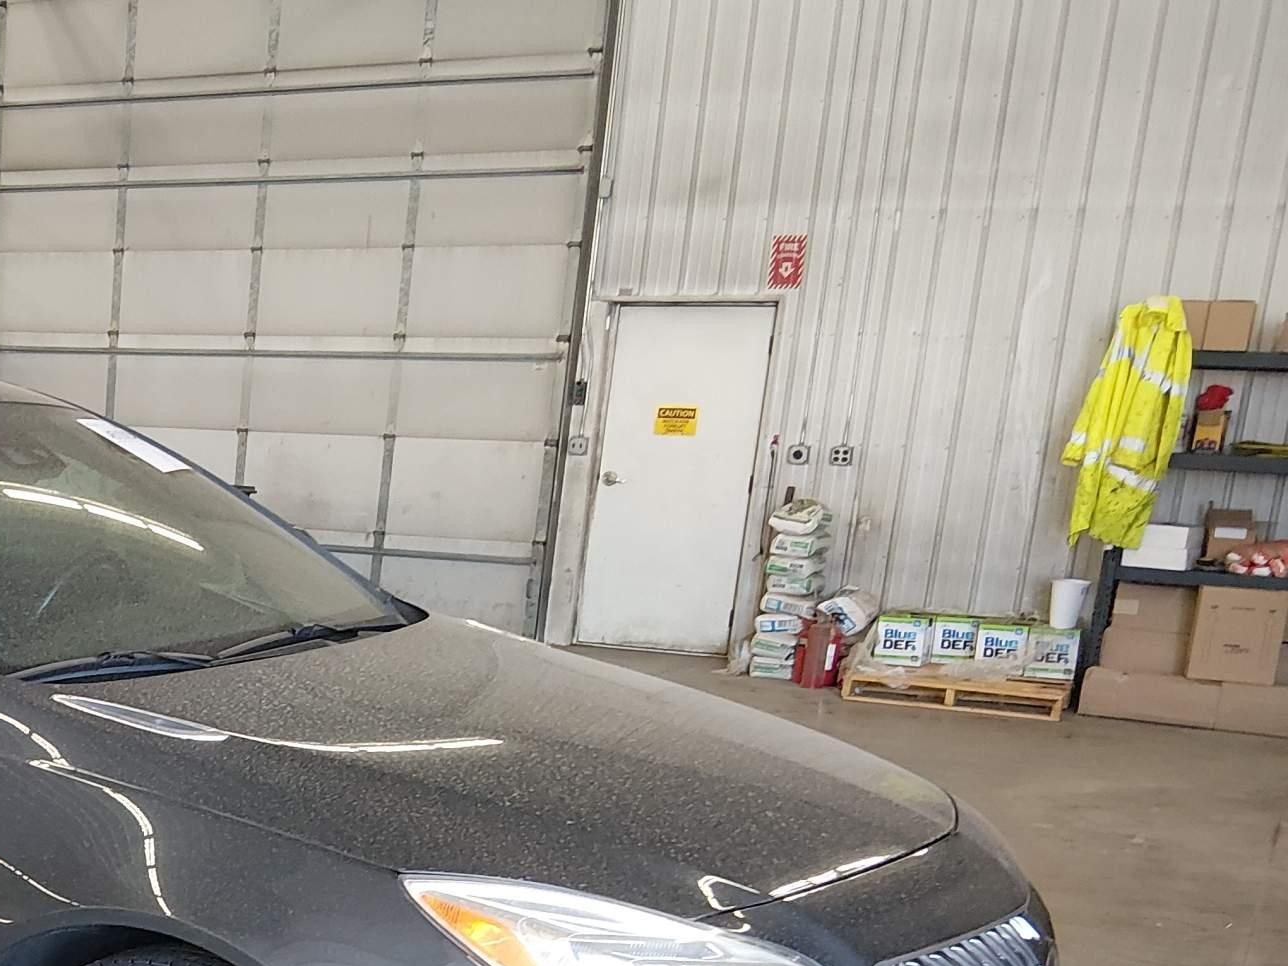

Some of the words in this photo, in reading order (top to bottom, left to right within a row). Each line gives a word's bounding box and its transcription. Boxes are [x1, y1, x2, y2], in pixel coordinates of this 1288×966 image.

[659, 409, 696, 418] CAUTION
[884, 628, 917, 640] Blue
[942, 628, 975, 640] Blue
[882, 639, 916, 650] DEF
[940, 639, 973, 650] DEF
[984, 636, 1018, 648] Blue
